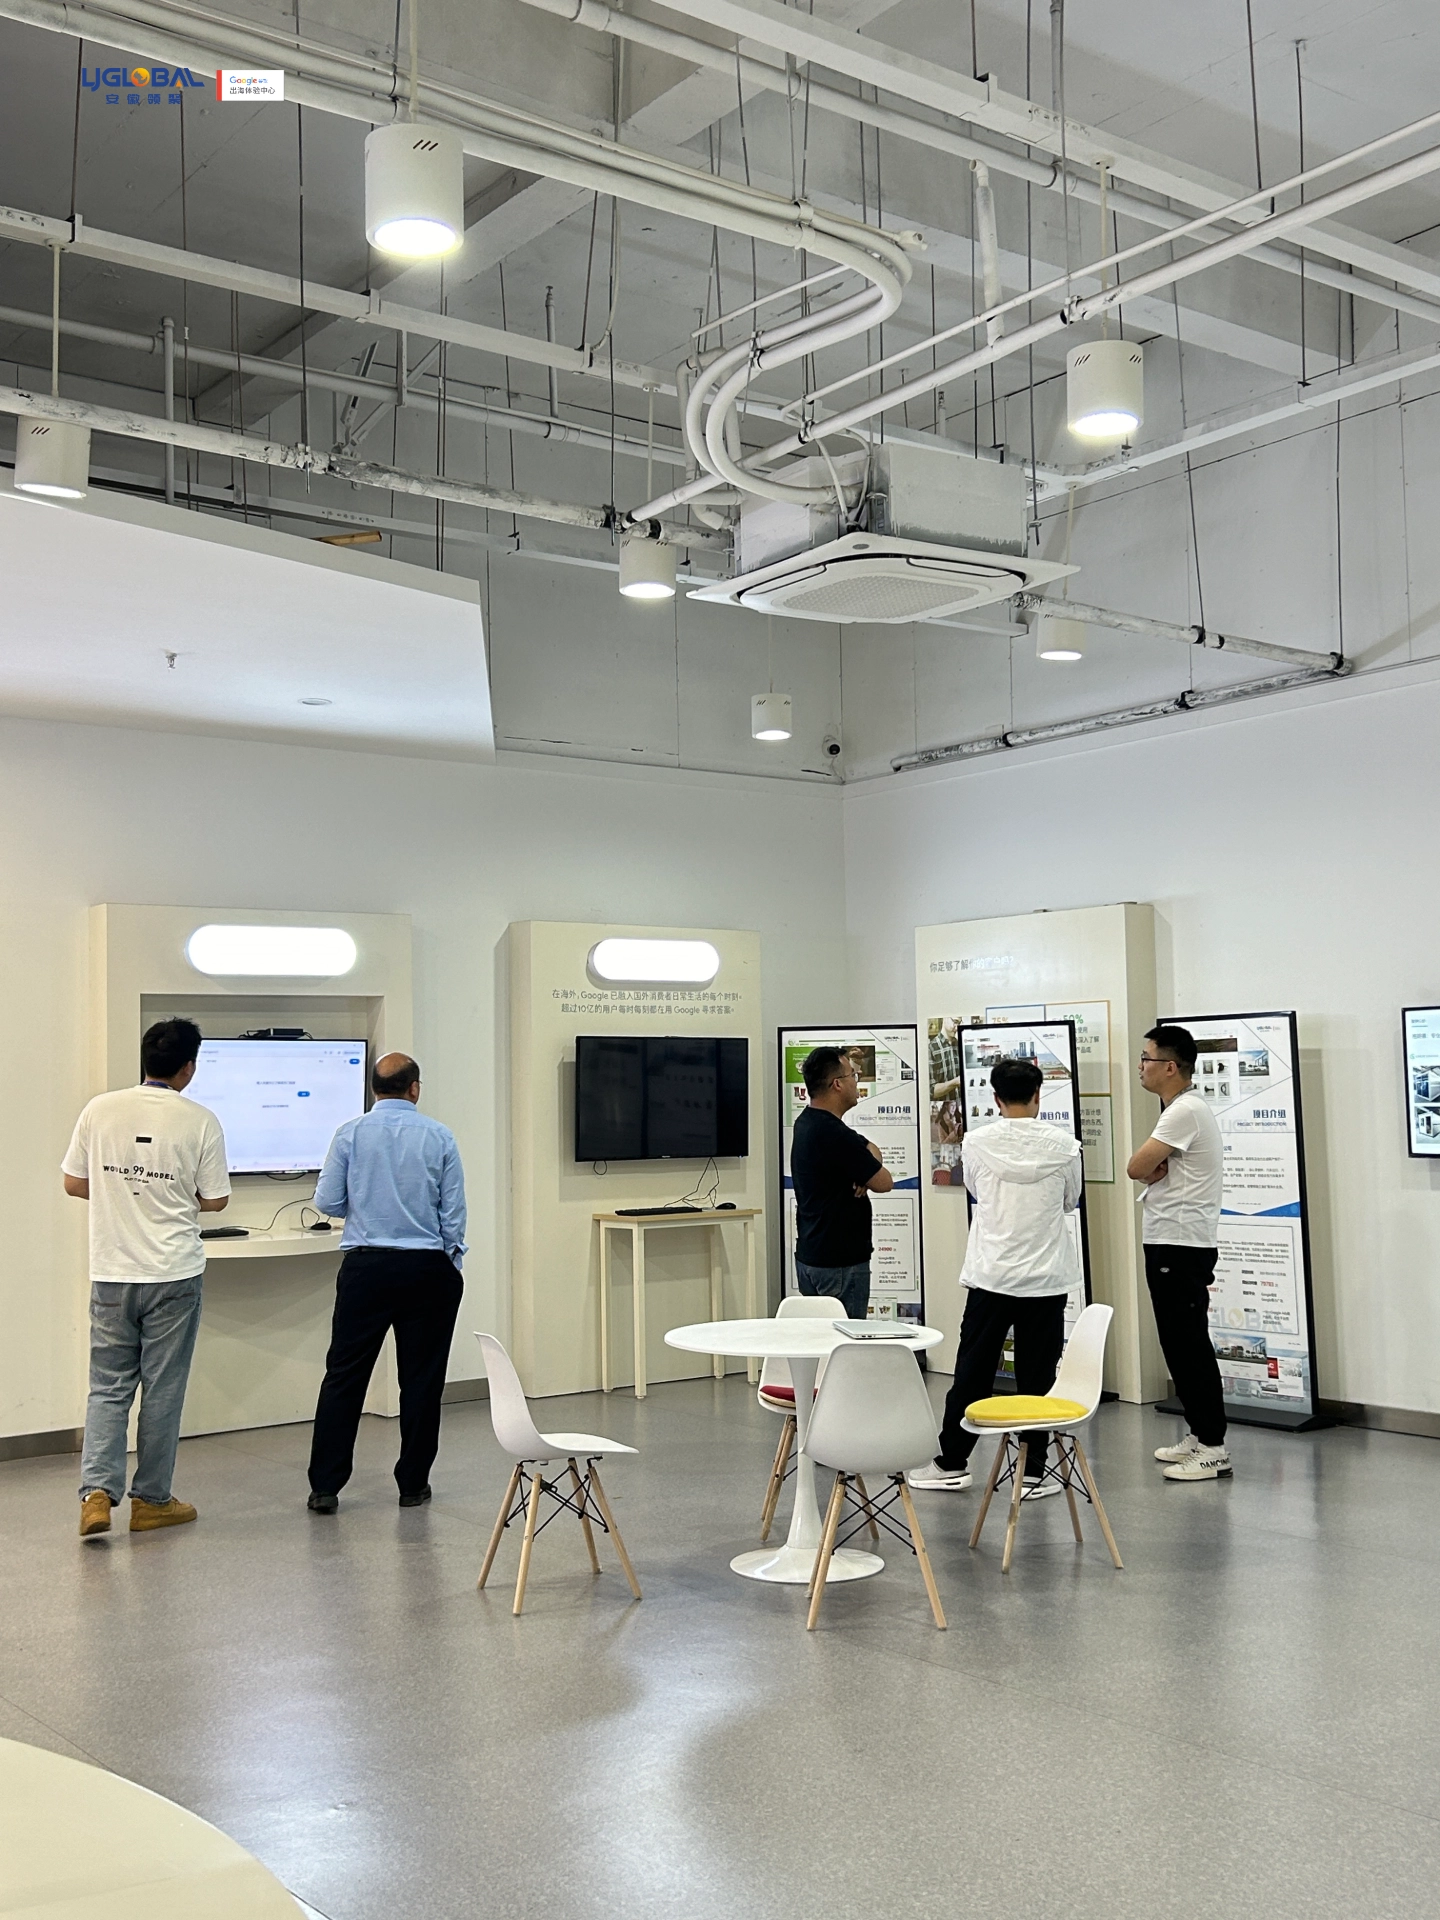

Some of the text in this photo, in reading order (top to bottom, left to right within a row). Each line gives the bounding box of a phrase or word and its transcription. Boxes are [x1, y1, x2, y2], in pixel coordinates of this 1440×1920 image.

[580, 990, 609, 1001] Google
[673, 1005, 700, 1016] Google
[1075, 1035, 1100, 1044] 深入了解
[132, 1165, 145, 1176] 99
[146, 1171, 175, 1181] MODEL
